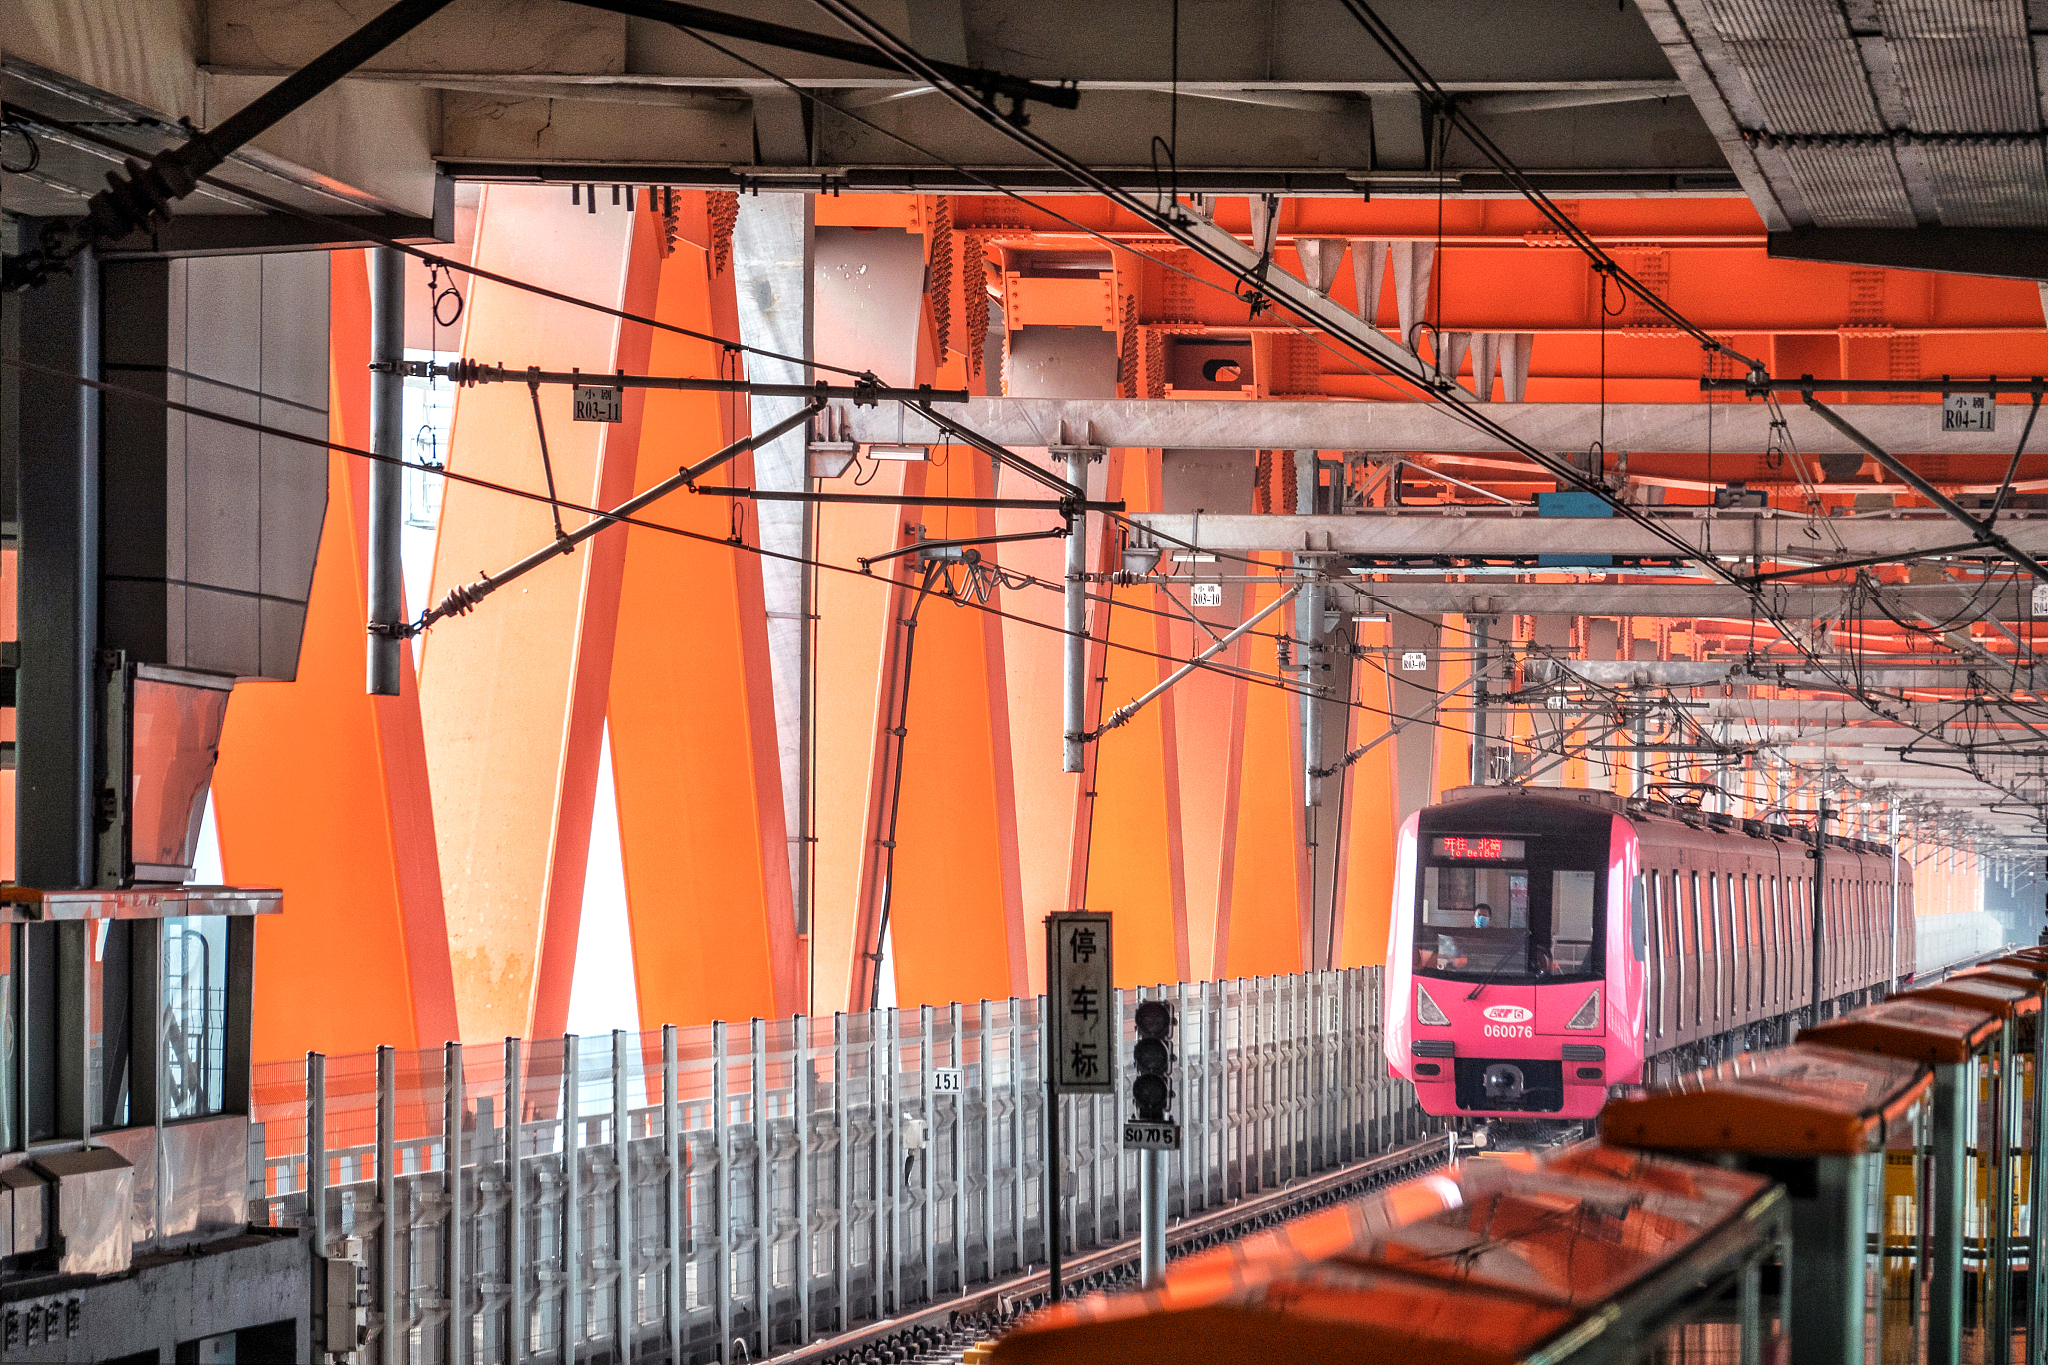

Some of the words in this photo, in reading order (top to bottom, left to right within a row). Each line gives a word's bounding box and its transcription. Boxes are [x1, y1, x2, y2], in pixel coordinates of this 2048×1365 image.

[576, 400, 619, 420] R03-11
[1946, 410, 1991, 428] R04-11
[1193, 593, 1220, 604] R03-10
[1444, 837, 1468, 851] 开往
[1467, 848, 1501, 859] BeiBei
[1070, 927, 1098, 1078] 停车标
[1484, 1024, 1533, 1039] 060076
[935, 1073, 959, 1090] 151
